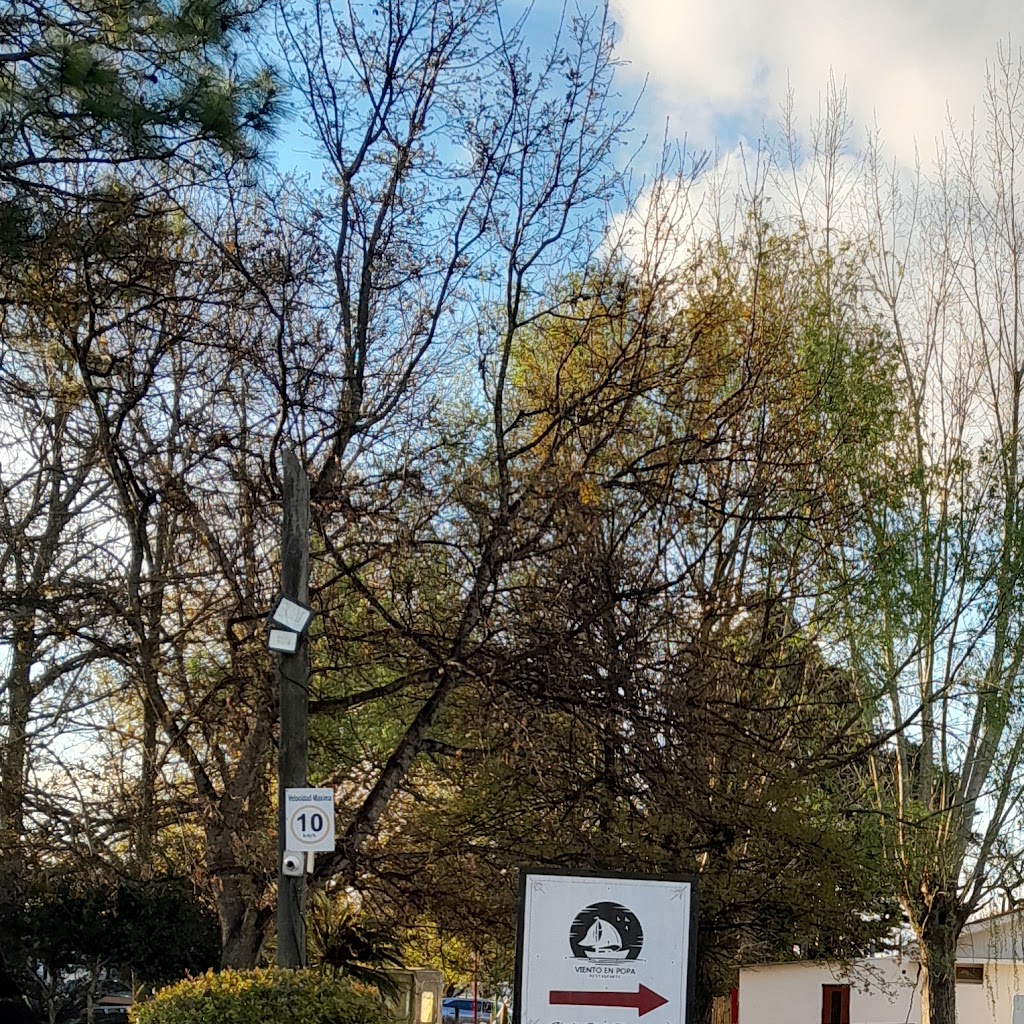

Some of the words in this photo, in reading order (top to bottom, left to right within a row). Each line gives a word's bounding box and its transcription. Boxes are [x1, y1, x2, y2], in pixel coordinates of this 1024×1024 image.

[296, 813, 323, 832] 10
[574, 966, 602, 974] VIENTO
[616, 967, 636, 975] POPA
